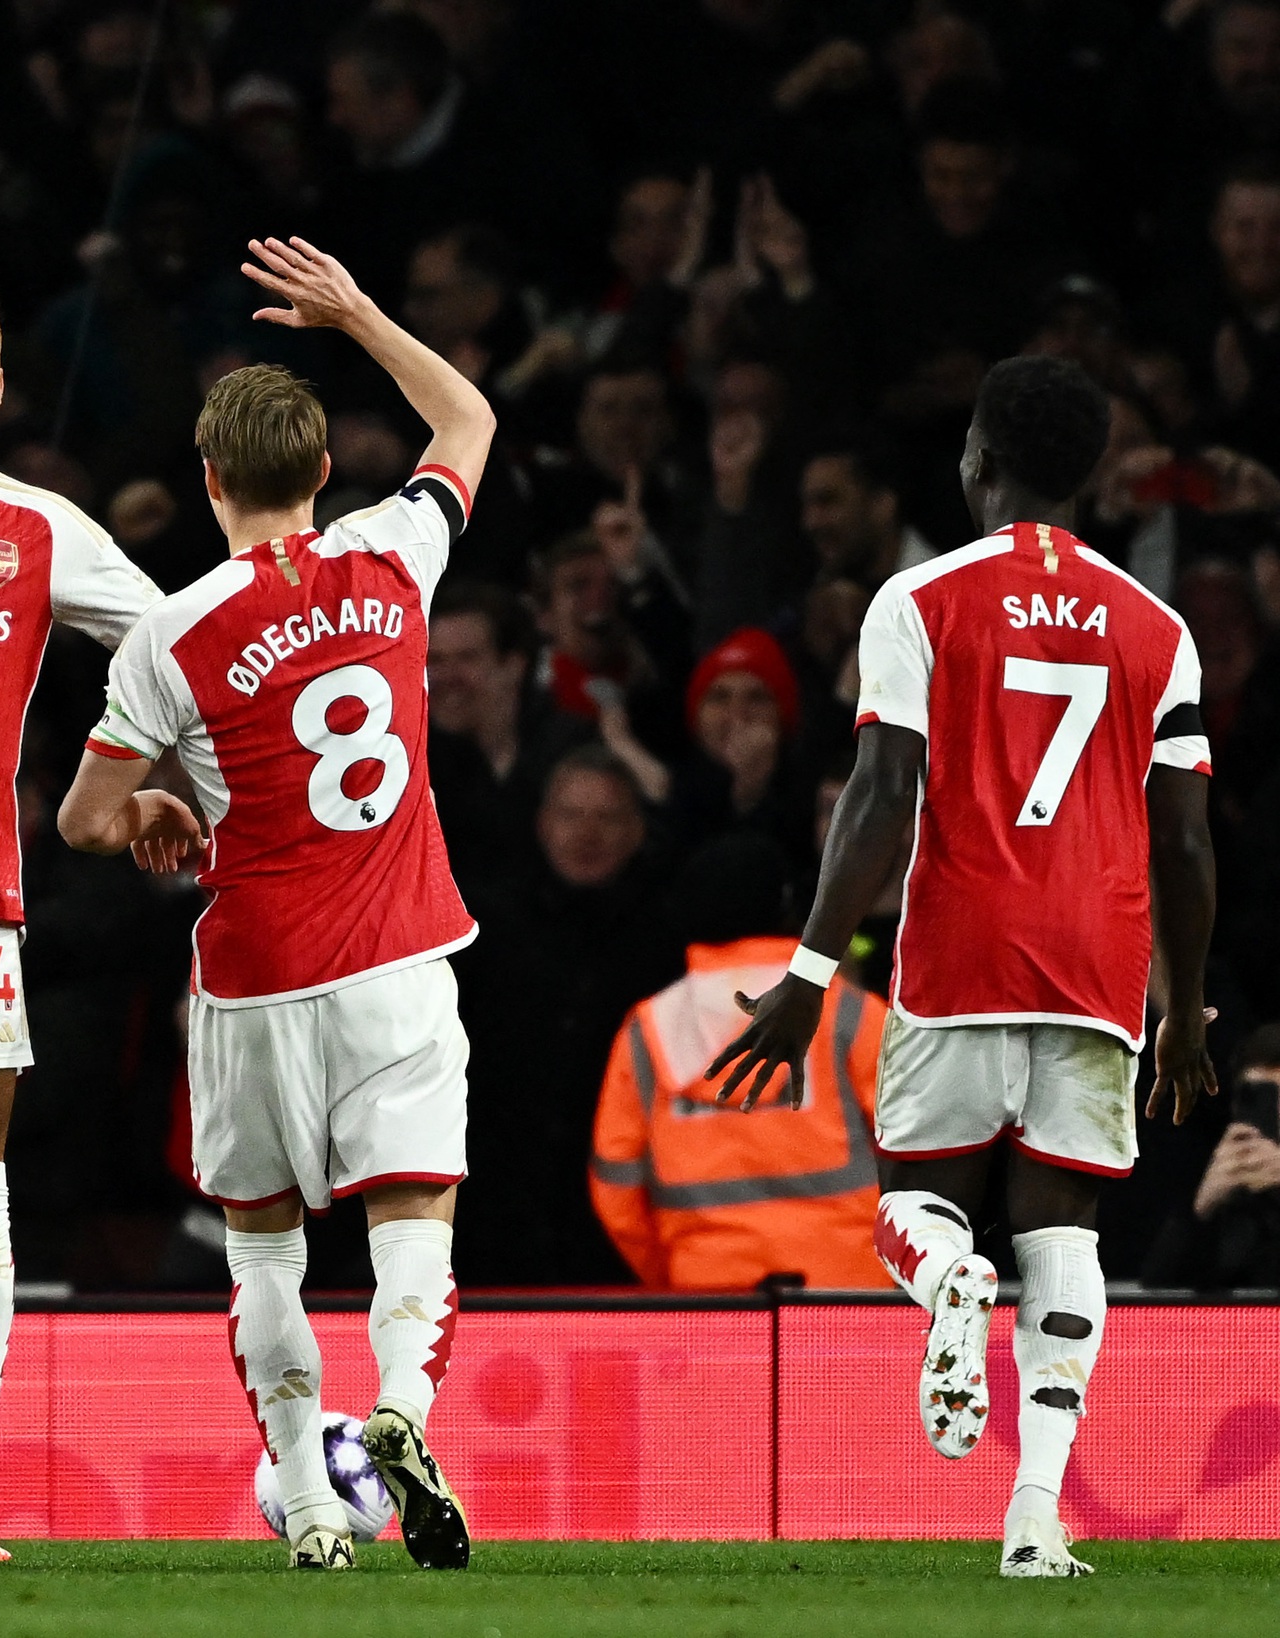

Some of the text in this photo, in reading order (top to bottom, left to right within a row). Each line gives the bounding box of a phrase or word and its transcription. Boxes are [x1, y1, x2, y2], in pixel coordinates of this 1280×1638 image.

[226, 598, 404, 697] ØDEGAARD
[1002, 593, 1109, 637] SAKA
[292, 664, 410, 831] 8
[1004, 656, 1109, 827] 7
